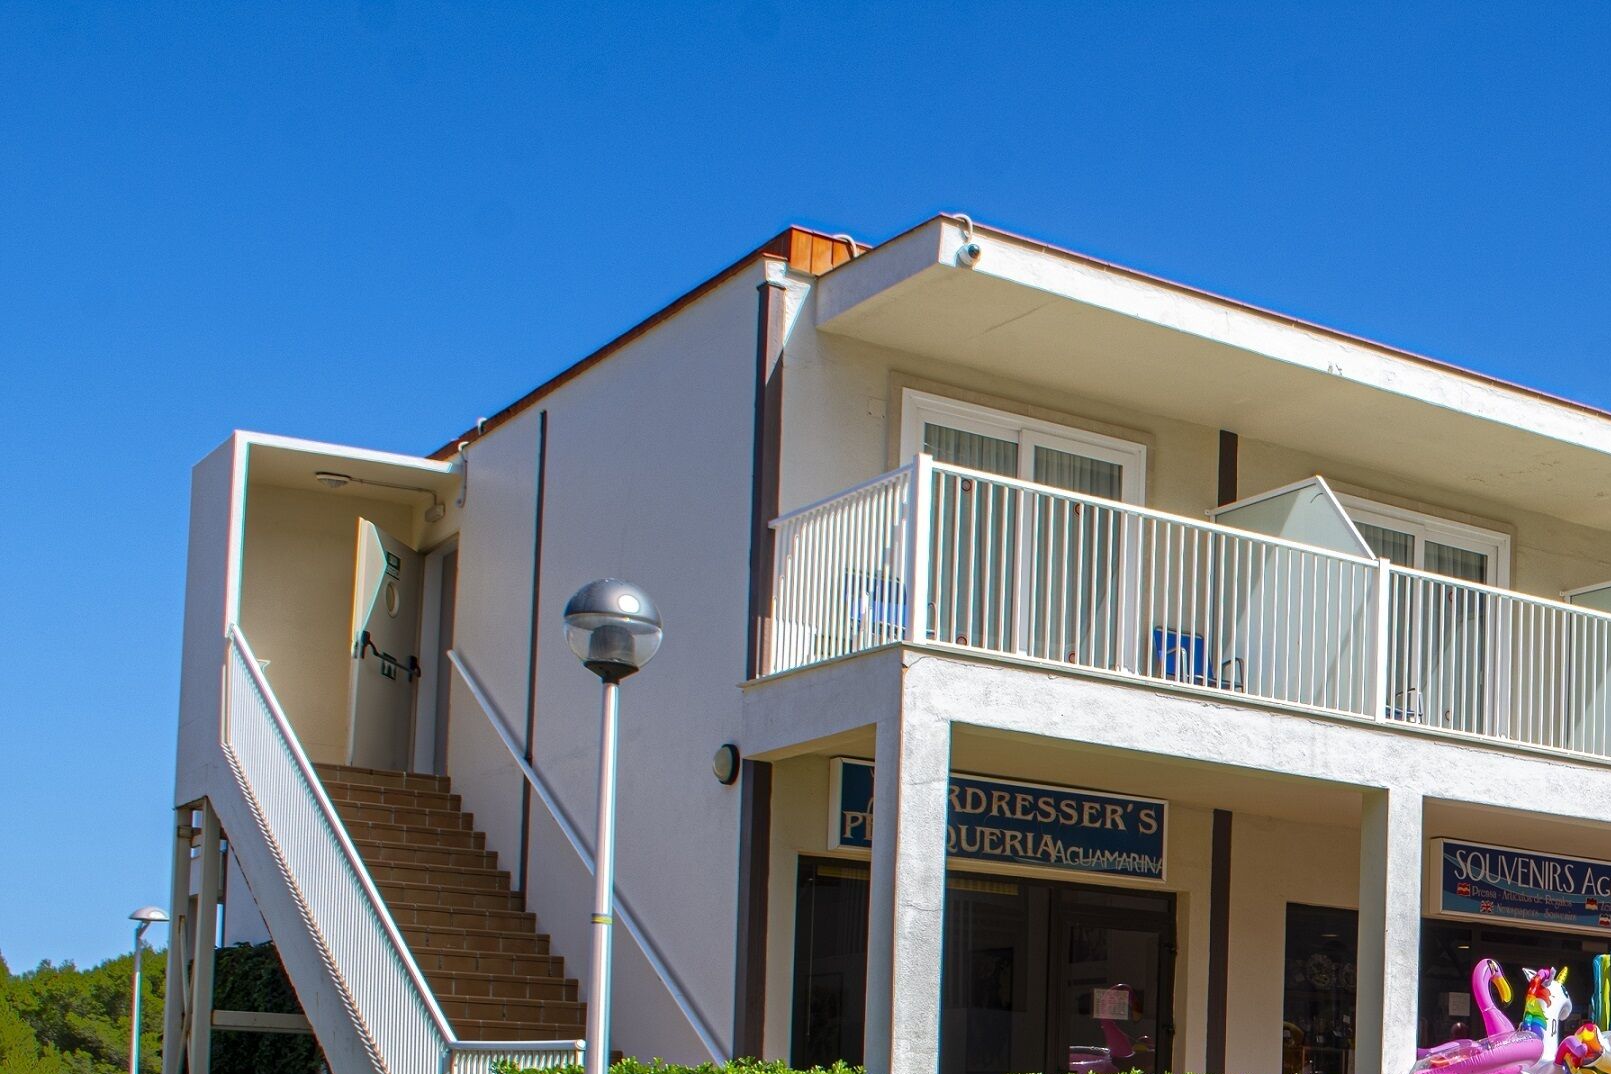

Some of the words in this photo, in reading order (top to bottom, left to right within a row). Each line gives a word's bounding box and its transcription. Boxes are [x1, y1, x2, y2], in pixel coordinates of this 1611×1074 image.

[950, 785, 1158, 834] RDRESSER'S
[1454, 849, 1575, 894] SOUVENIRS
[1471, 885, 1497, 899] Prensa
[1496, 903, 1539, 919] Newspapers
